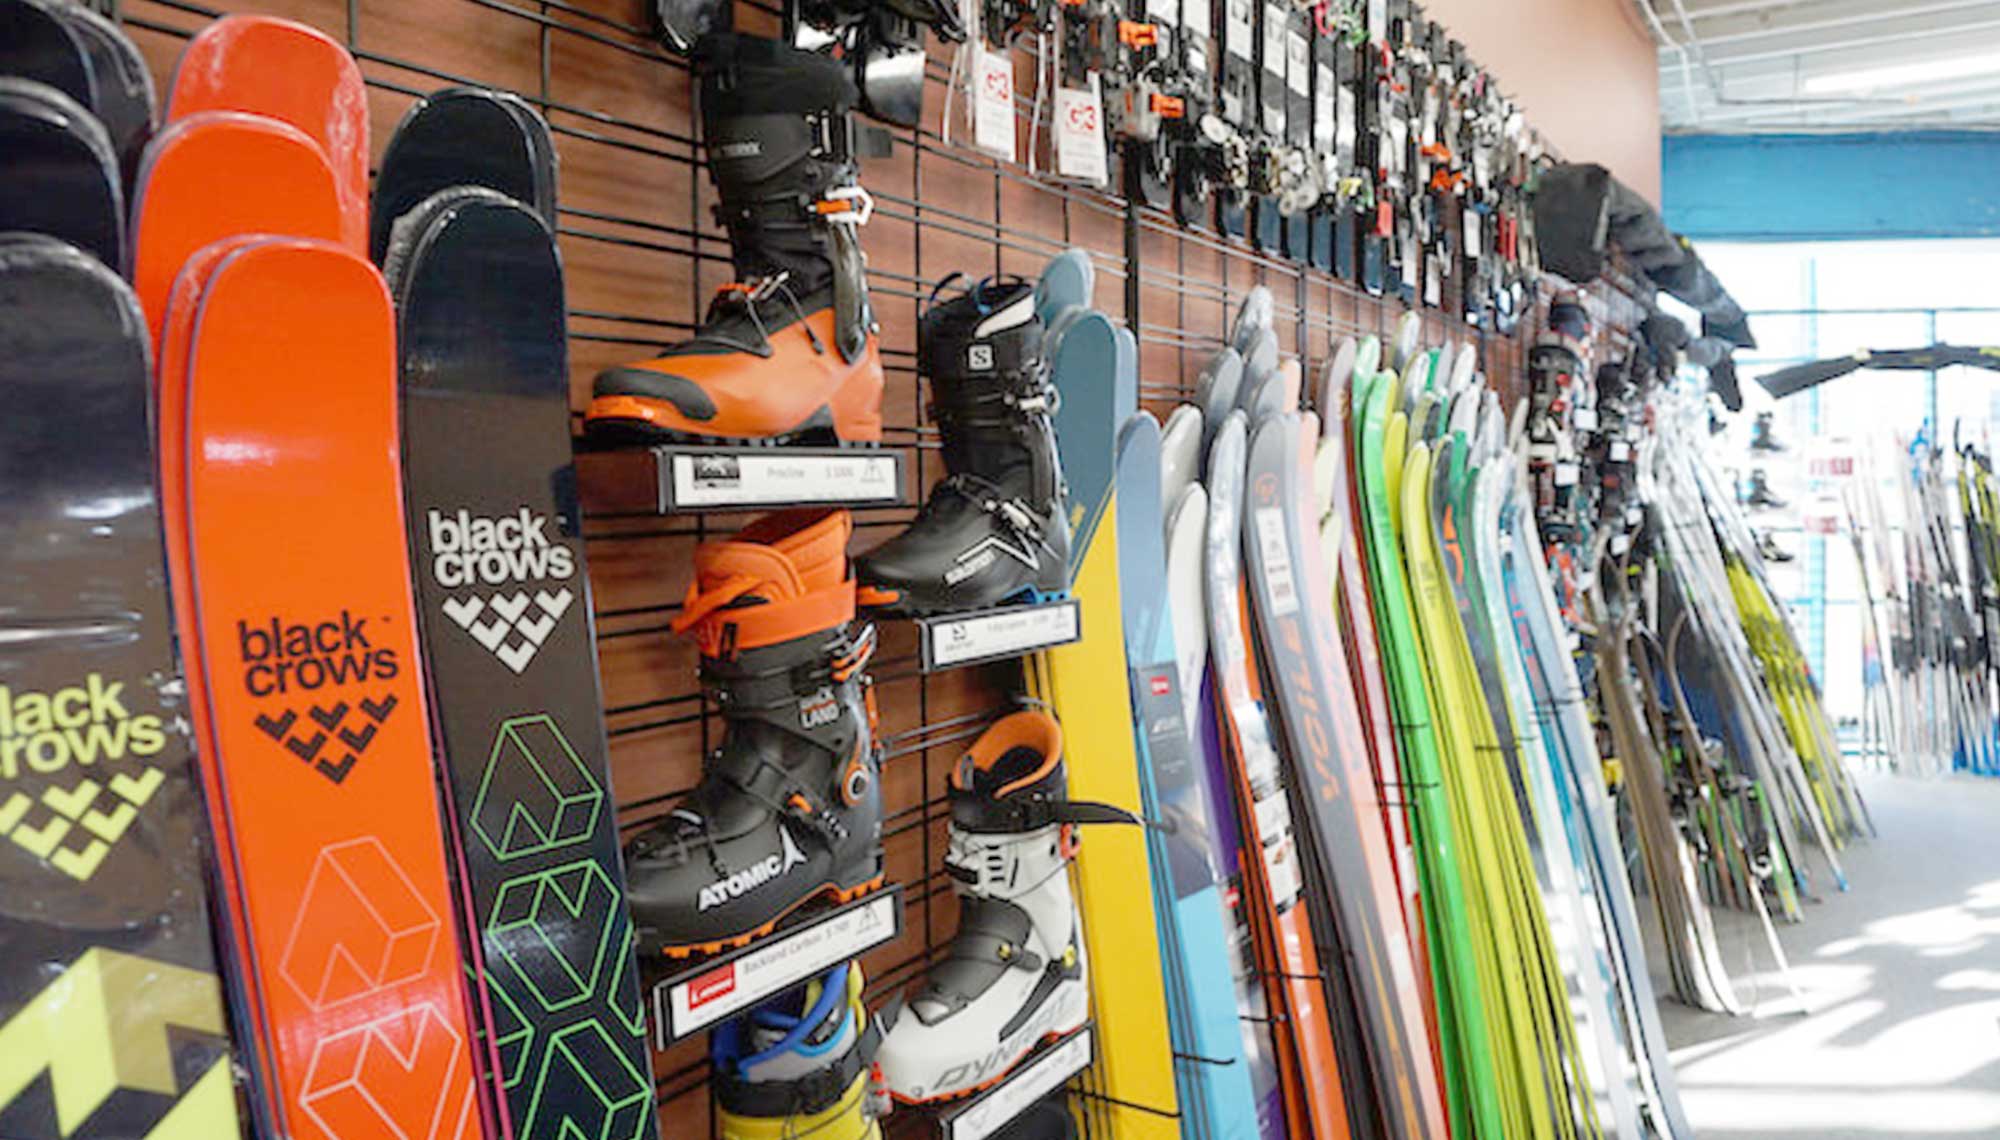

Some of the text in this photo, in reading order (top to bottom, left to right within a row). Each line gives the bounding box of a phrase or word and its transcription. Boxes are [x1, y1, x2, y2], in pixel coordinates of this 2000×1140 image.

[427, 506, 549, 554] black
[434, 544, 576, 588] crows
[237, 609, 371, 662] black
[246, 649, 398, 697] crows
[0, 672, 129, 735] lack
[0, 714, 167, 779] rows
[699, 854, 782, 912] ATOMIC
